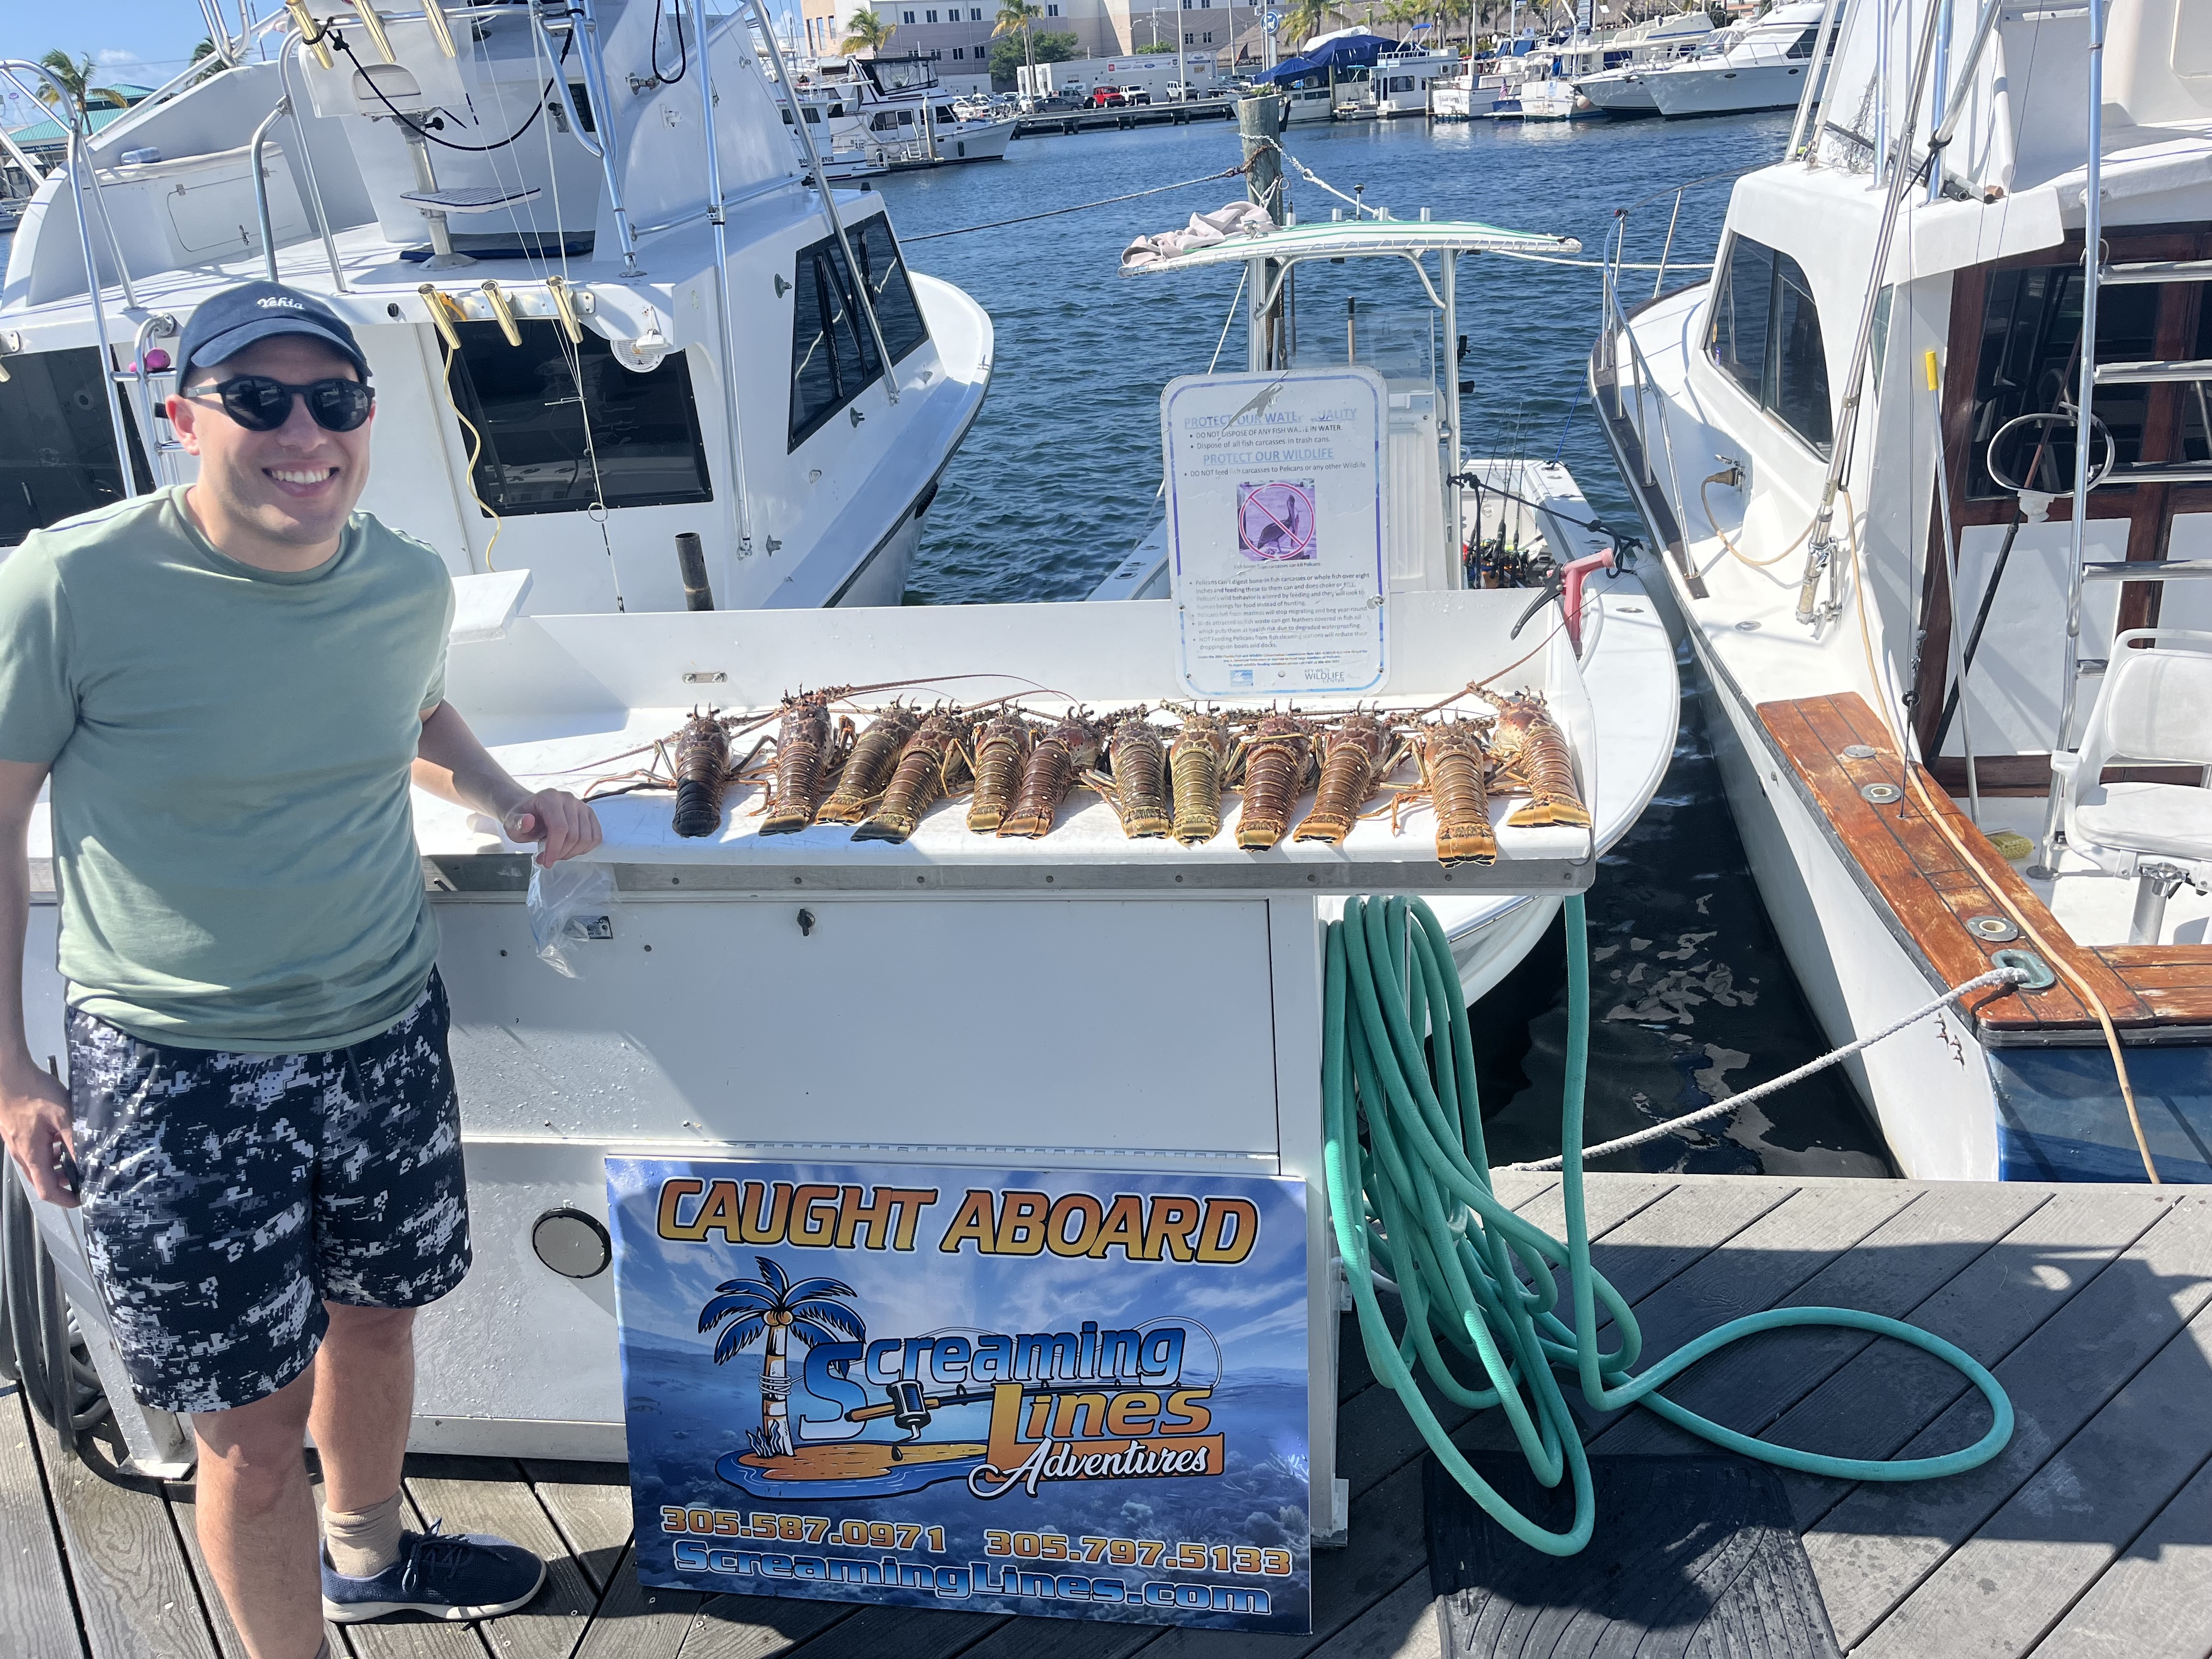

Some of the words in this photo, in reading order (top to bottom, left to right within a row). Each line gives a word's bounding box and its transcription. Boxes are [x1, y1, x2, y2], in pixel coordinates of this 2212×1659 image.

[1185, 414, 1233, 428] PROTECT
[1237, 414, 1261, 425] OUR
[1265, 411, 1304, 423] WATE
[1311, 408, 1357, 421] UALITY
[1197, 442, 1222, 450] Dispose
[1204, 453, 1252, 464] PROTECT
[1255, 451, 1279, 461] OUR
[1283, 448, 1333, 460] WILDLIFE
[1224, 585, 1245, 594] feeding
[1289, 591, 1310, 599] feeding
[1216, 602, 1233, 610] beings
[1288, 607, 1314, 616] migrating
[1295, 624, 1320, 632] degraded
[1321, 623, 1361, 631] waterproofing.
[1279, 632, 1301, 640] cleaning
[1200, 643, 1225, 651] droppings
[1305, 672, 1344, 680] WILDLIFE
[658, 1179, 938, 1251] CAUGHT
[939, 1189, 1257, 1263] ABOARD
[798, 1321, 1186, 1441] Screaming
[986, 1383, 1224, 1482] Lines
[967, 1437, 1209, 1499] Adventures
[662, 1506, 945, 1552] 305.587.0971
[986, 1531, 1292, 1575] 305.797.5133
[675, 1541, 1271, 1615] ScreamingLines.com
